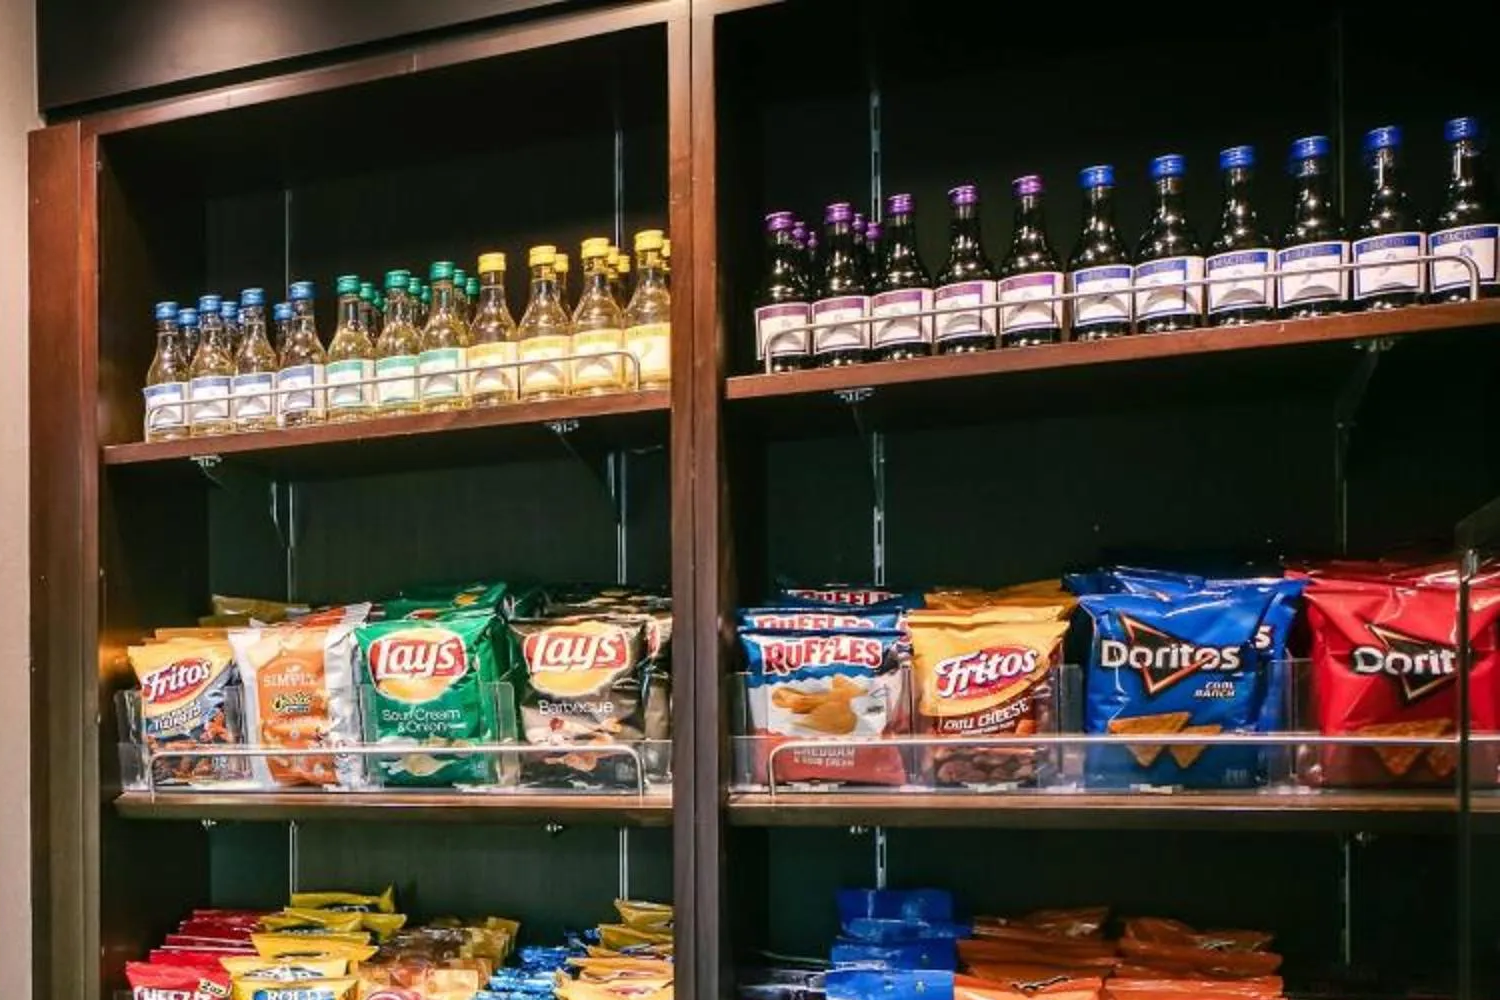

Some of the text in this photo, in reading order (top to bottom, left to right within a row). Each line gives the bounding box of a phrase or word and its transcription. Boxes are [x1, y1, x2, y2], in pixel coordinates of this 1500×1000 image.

[375, 634, 459, 681] Lay's
[531, 629, 620, 672] Lay's
[762, 635, 884, 675] RUFFLES
[1101, 640, 1241, 671] Doritos
[1353, 645, 1460, 677] Dorit
[142, 658, 213, 697] Fritos
[935, 648, 1038, 698] Fritos
[977, 698, 1030, 728] CHEESE
